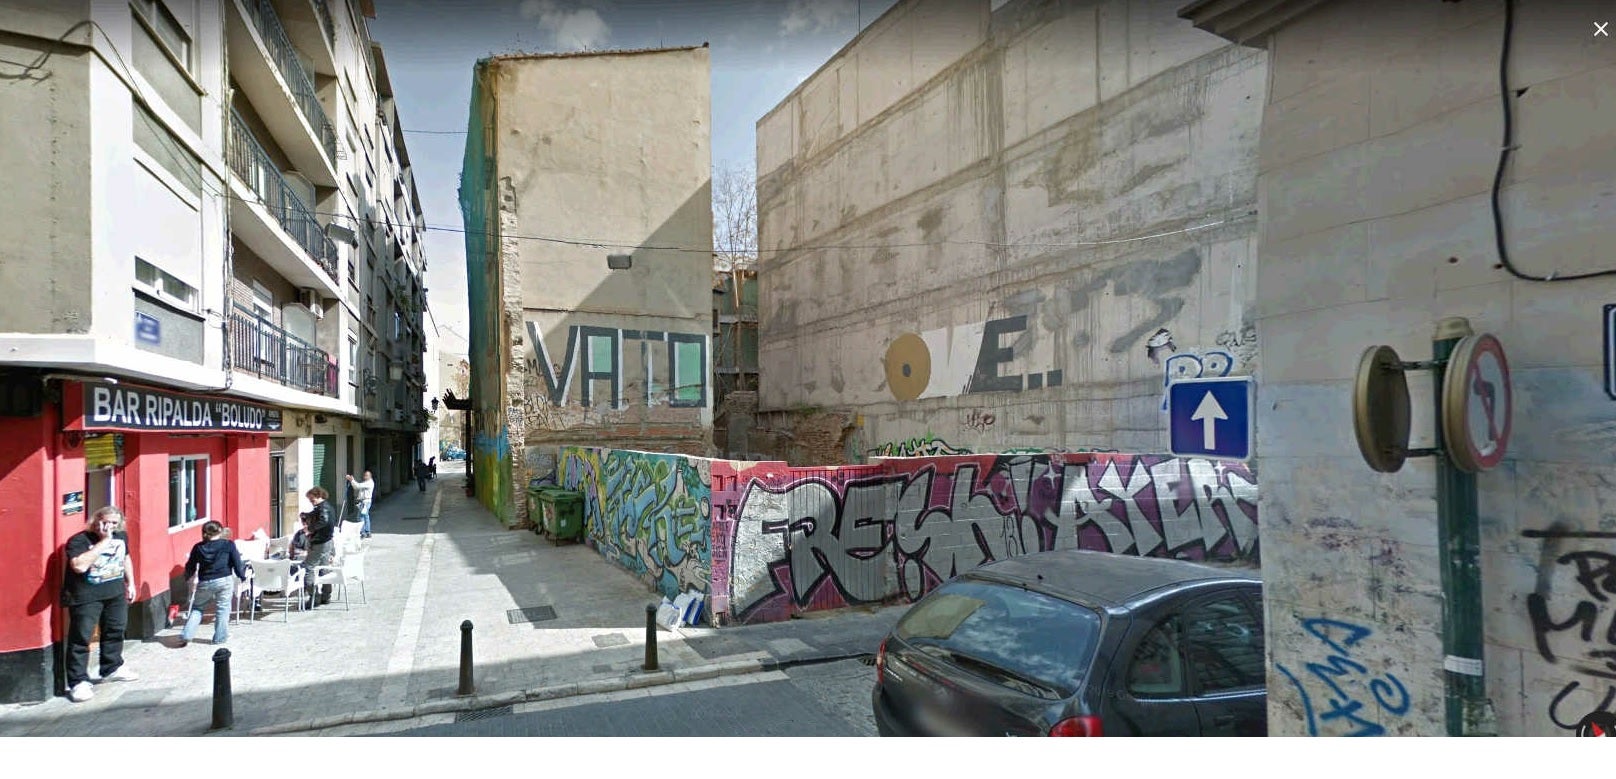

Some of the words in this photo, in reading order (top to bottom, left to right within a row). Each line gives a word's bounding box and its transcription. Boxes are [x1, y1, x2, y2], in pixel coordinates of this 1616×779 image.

[525, 321, 709, 410] VATO
[94, 387, 141, 425] BAR
[145, 394, 213, 427] RIPALDA
